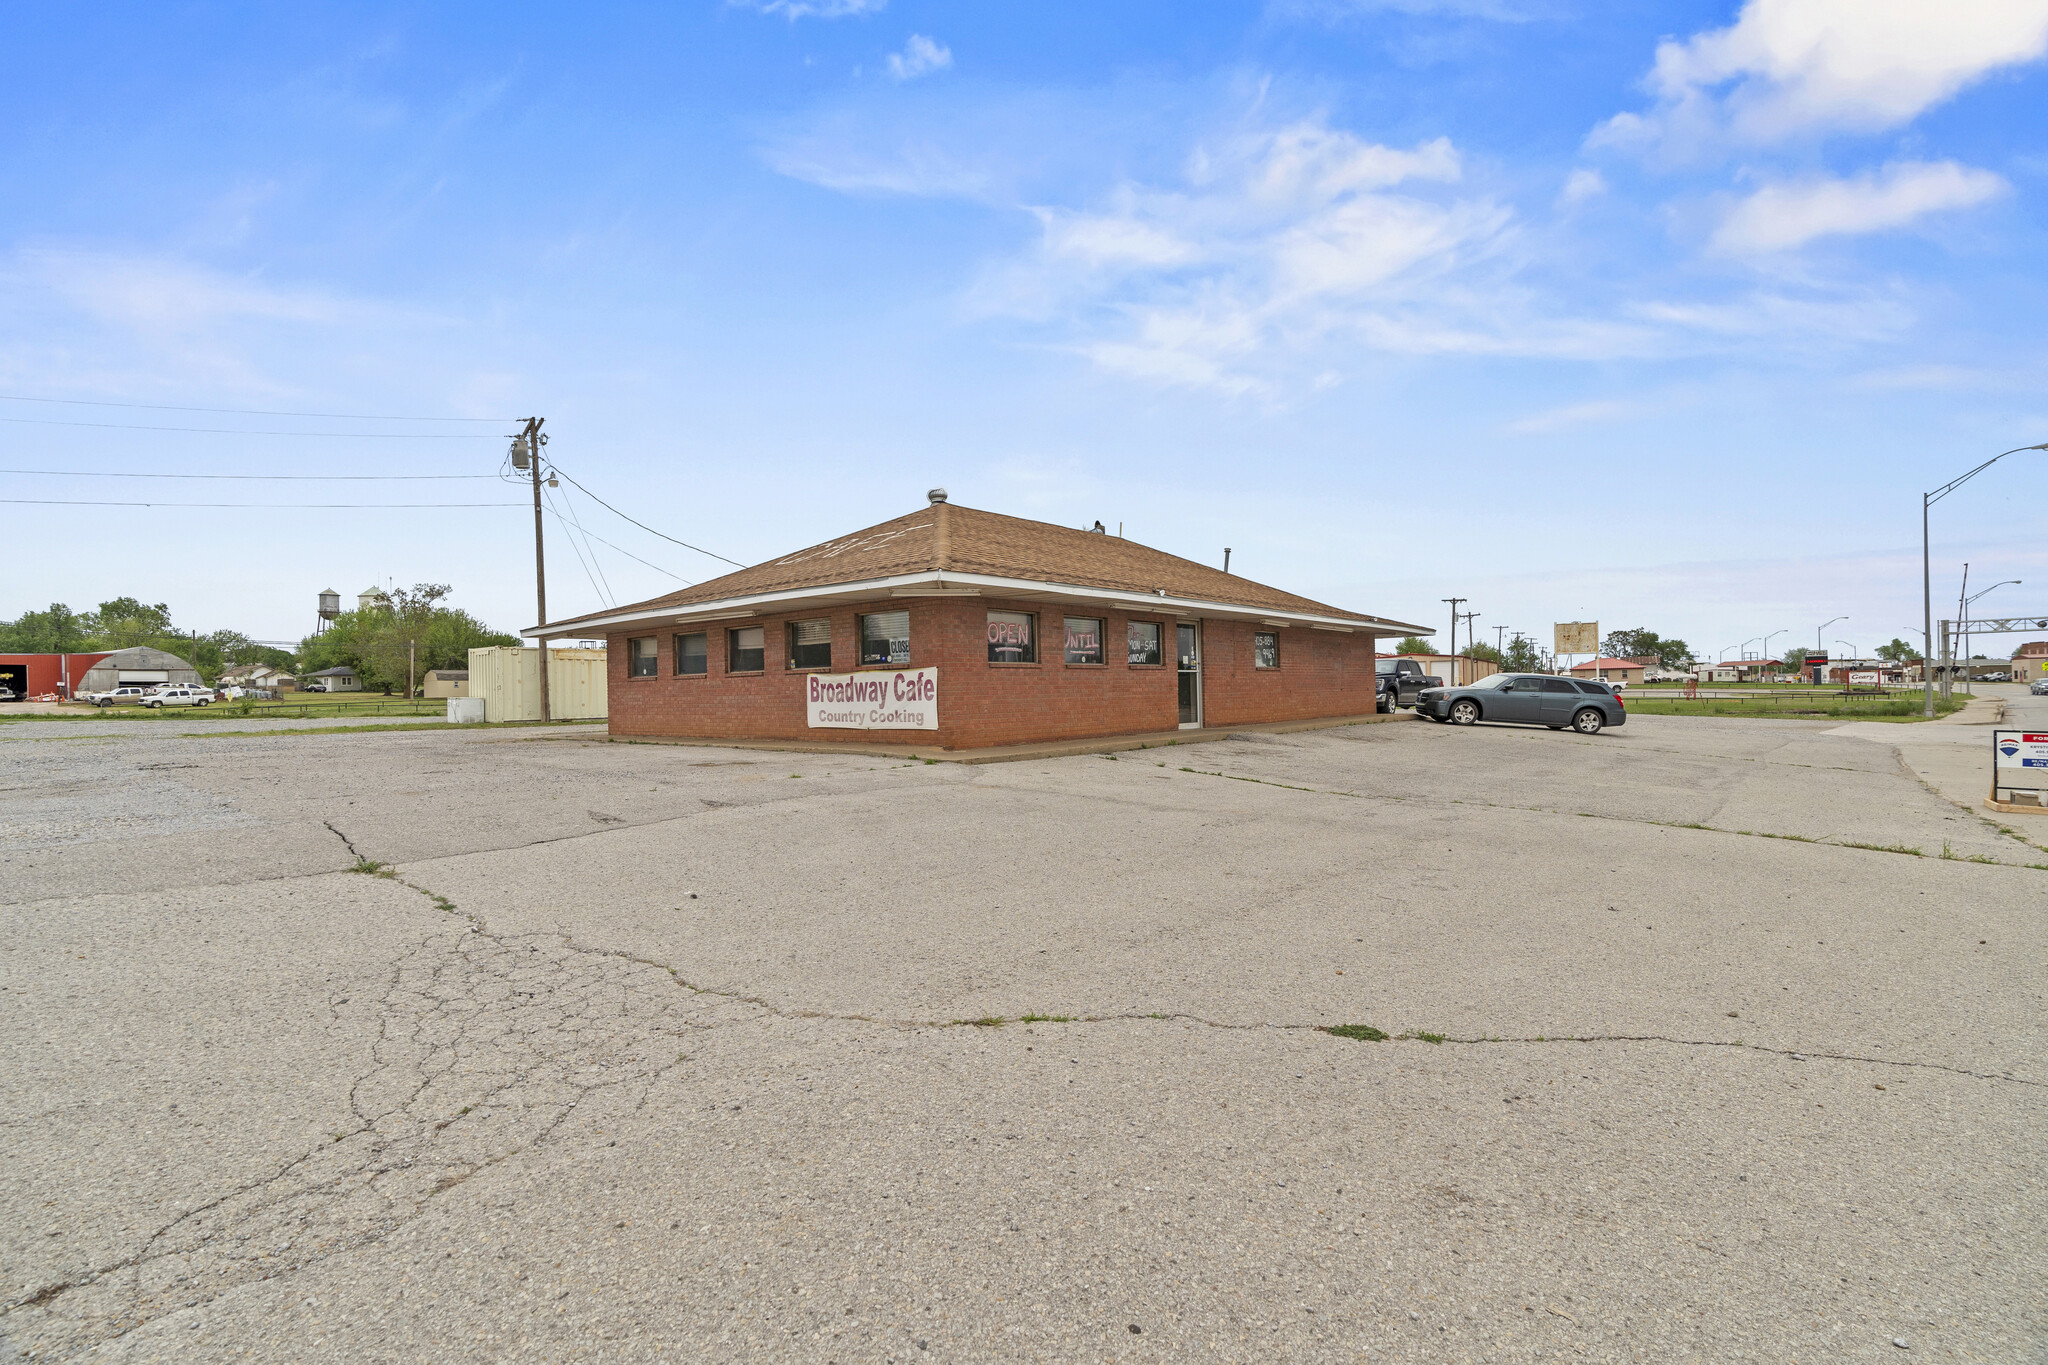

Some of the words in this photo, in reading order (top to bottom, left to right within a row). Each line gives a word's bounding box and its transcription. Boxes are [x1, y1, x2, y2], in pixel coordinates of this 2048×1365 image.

[988, 621, 1029, 645] OPEN
[1128, 652, 1147, 663] UNDAY
[810, 676, 888, 709] Broadway
[893, 672, 935, 702] Cafe
[819, 709, 866, 726] Country
[869, 709, 924, 726] Cooking
